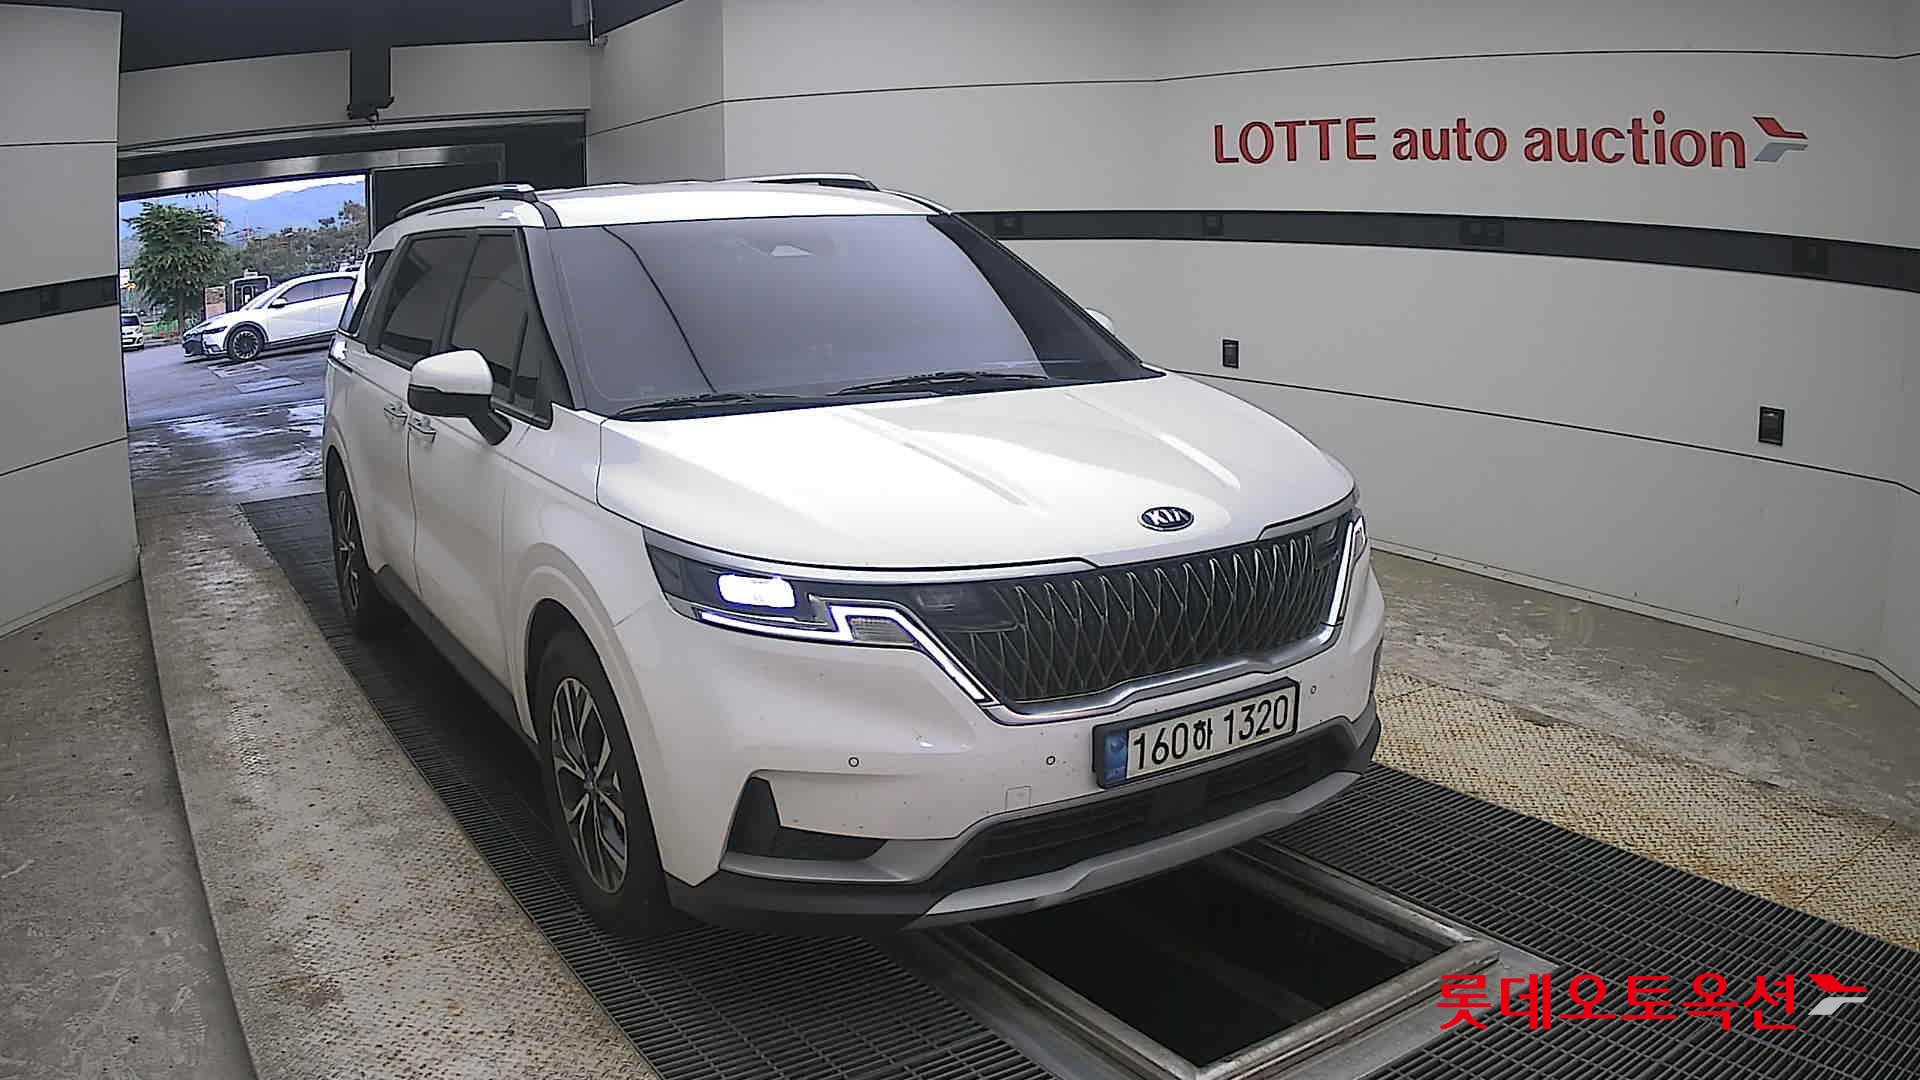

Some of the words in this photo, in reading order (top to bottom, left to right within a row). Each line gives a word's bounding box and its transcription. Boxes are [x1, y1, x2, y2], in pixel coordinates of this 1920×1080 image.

[1214, 116, 1377, 165] LOTTE
[1392, 117, 1508, 162] auto
[1523, 110, 1748, 169] auction
[1145, 508, 1190, 526] KIA
[1133, 717, 1214, 770] 160하
[1224, 695, 1288, 745] 1320
